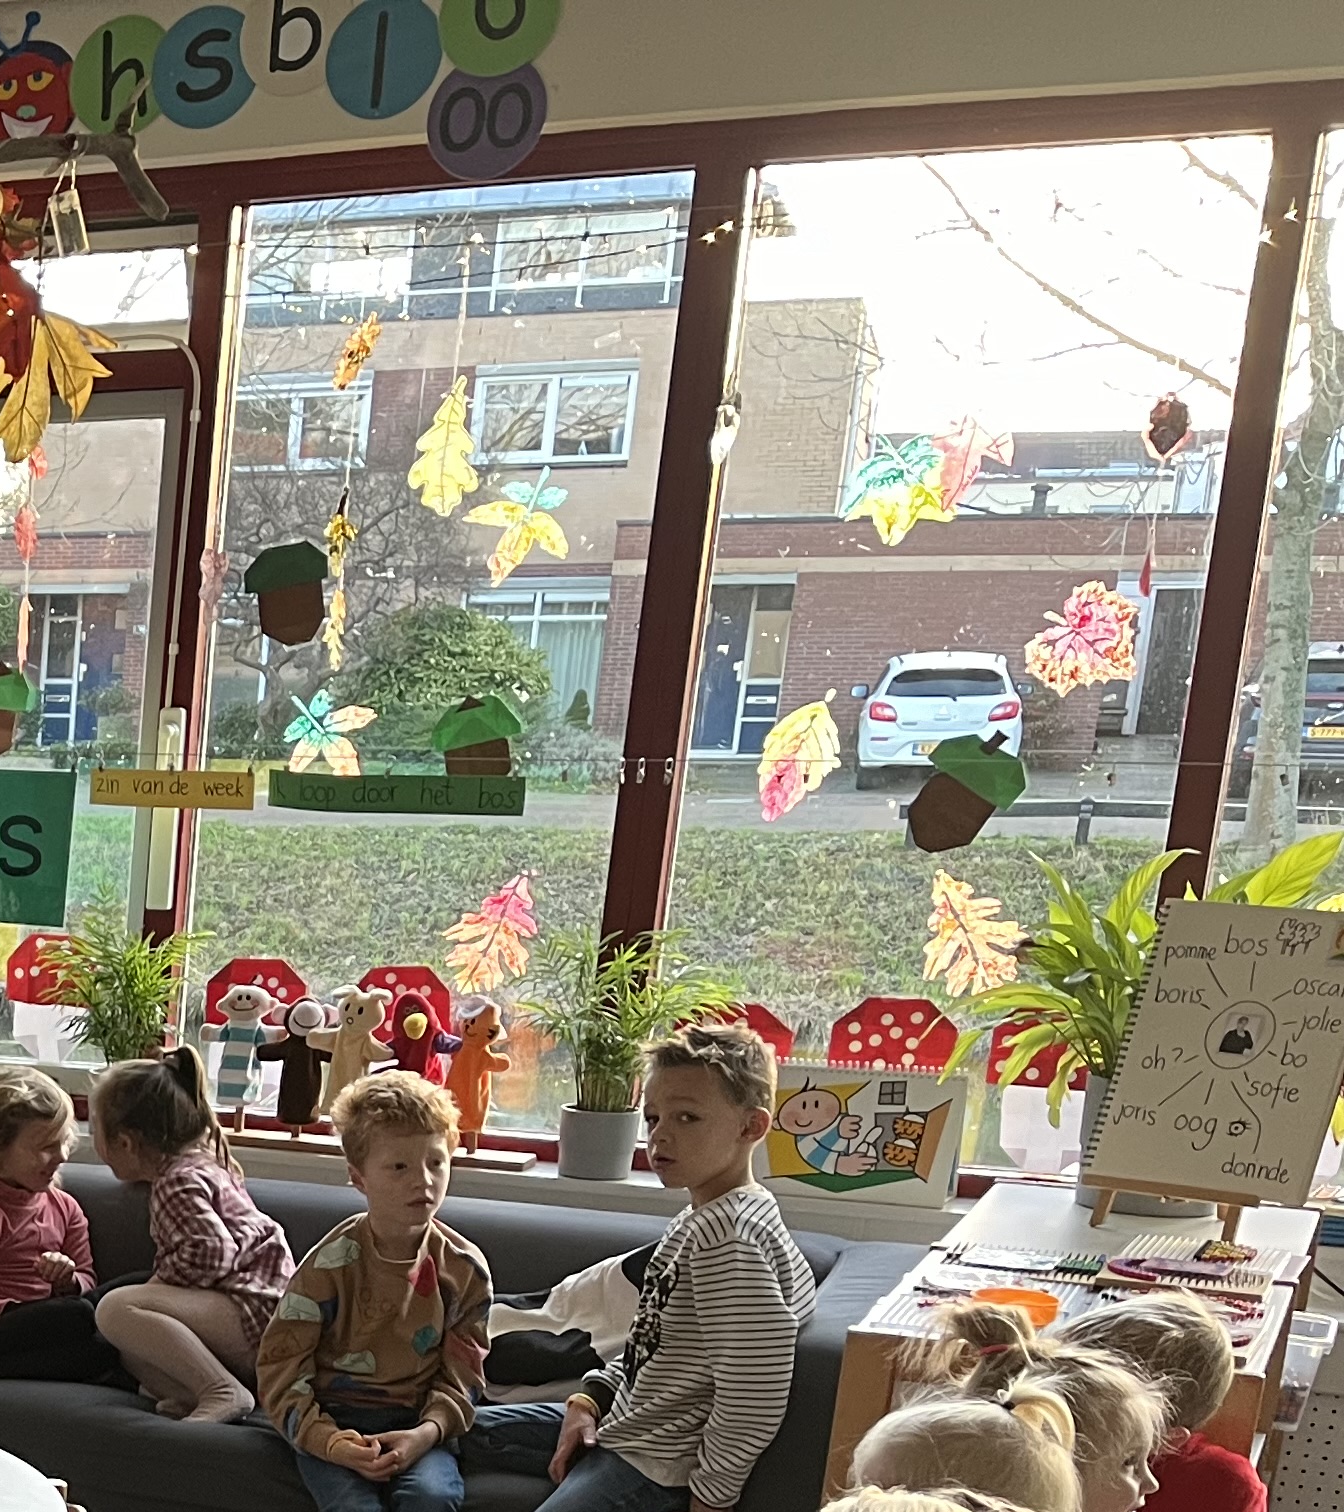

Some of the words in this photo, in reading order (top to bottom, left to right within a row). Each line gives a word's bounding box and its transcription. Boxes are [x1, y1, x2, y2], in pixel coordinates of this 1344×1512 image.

[203, 775, 245, 798] week
[352, 778, 398, 804] door
[421, 778, 455, 807] het
[477, 777, 519, 809] bos
[1223, 924, 1269, 956] bos
[1155, 976, 1206, 1004] boris
[1292, 1005, 1342, 1043] jolie
[1280, 1040, 1308, 1068] bo
[1247, 1073, 1300, 1109] sofie
[1112, 1102, 1157, 1126] joris
[1173, 1112, 1218, 1151] oog
